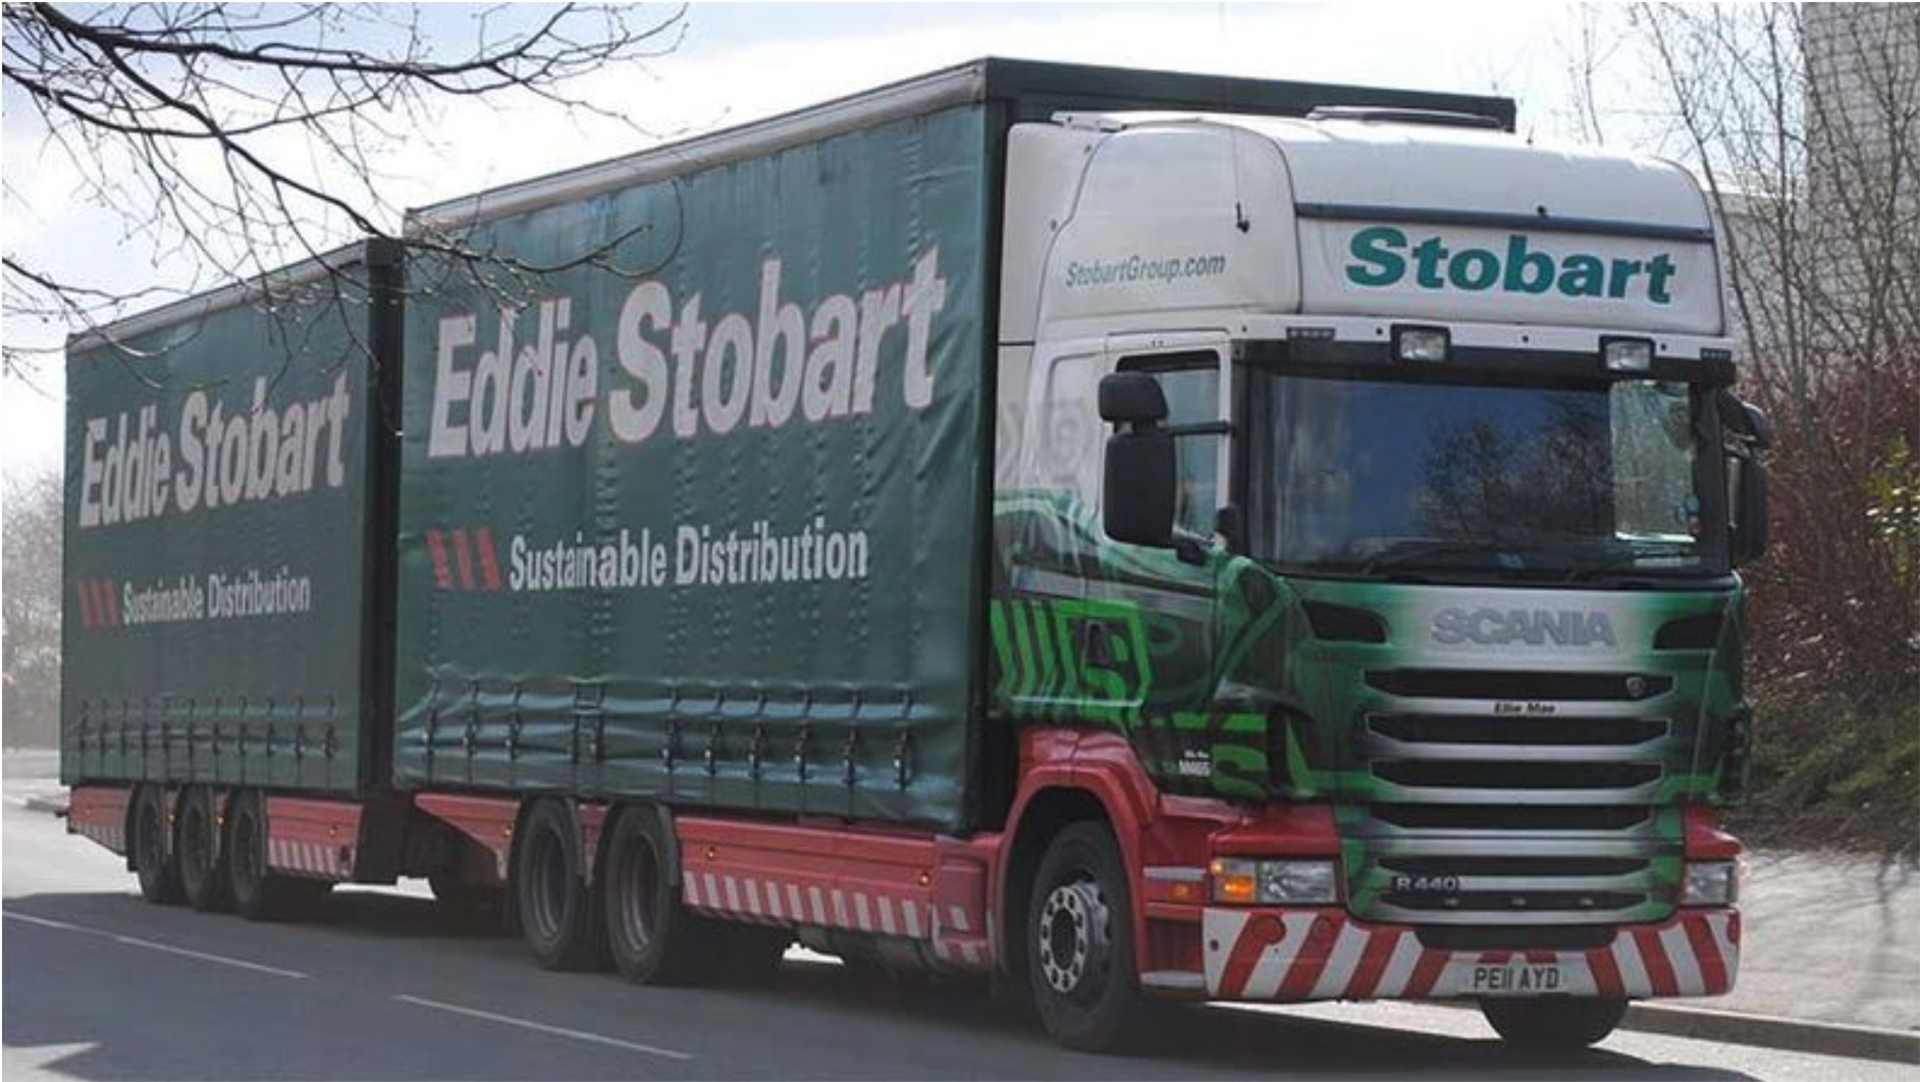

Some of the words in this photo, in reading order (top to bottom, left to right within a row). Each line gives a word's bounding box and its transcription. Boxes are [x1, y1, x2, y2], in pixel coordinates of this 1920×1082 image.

[1064, 252, 1226, 289] StobartGroup.com
[1345, 227, 1675, 304] Stobart
[428, 298, 598, 458] Eddie
[608, 246, 947, 444] Stobart
[79, 404, 172, 528] Eddie
[176, 369, 350, 513] Stobart
[509, 527, 667, 591] Sustainable
[675, 516, 868, 587] Distribution
[122, 575, 204, 626] Sustainable
[207, 564, 311, 616] Distribution
[1430, 607, 1618, 648] SCANIA
[1396, 876, 1412, 891] R
[1414, 876, 1458, 892] 440
[1474, 967, 1513, 990] PE11
[1518, 967, 1560, 990] AYD
